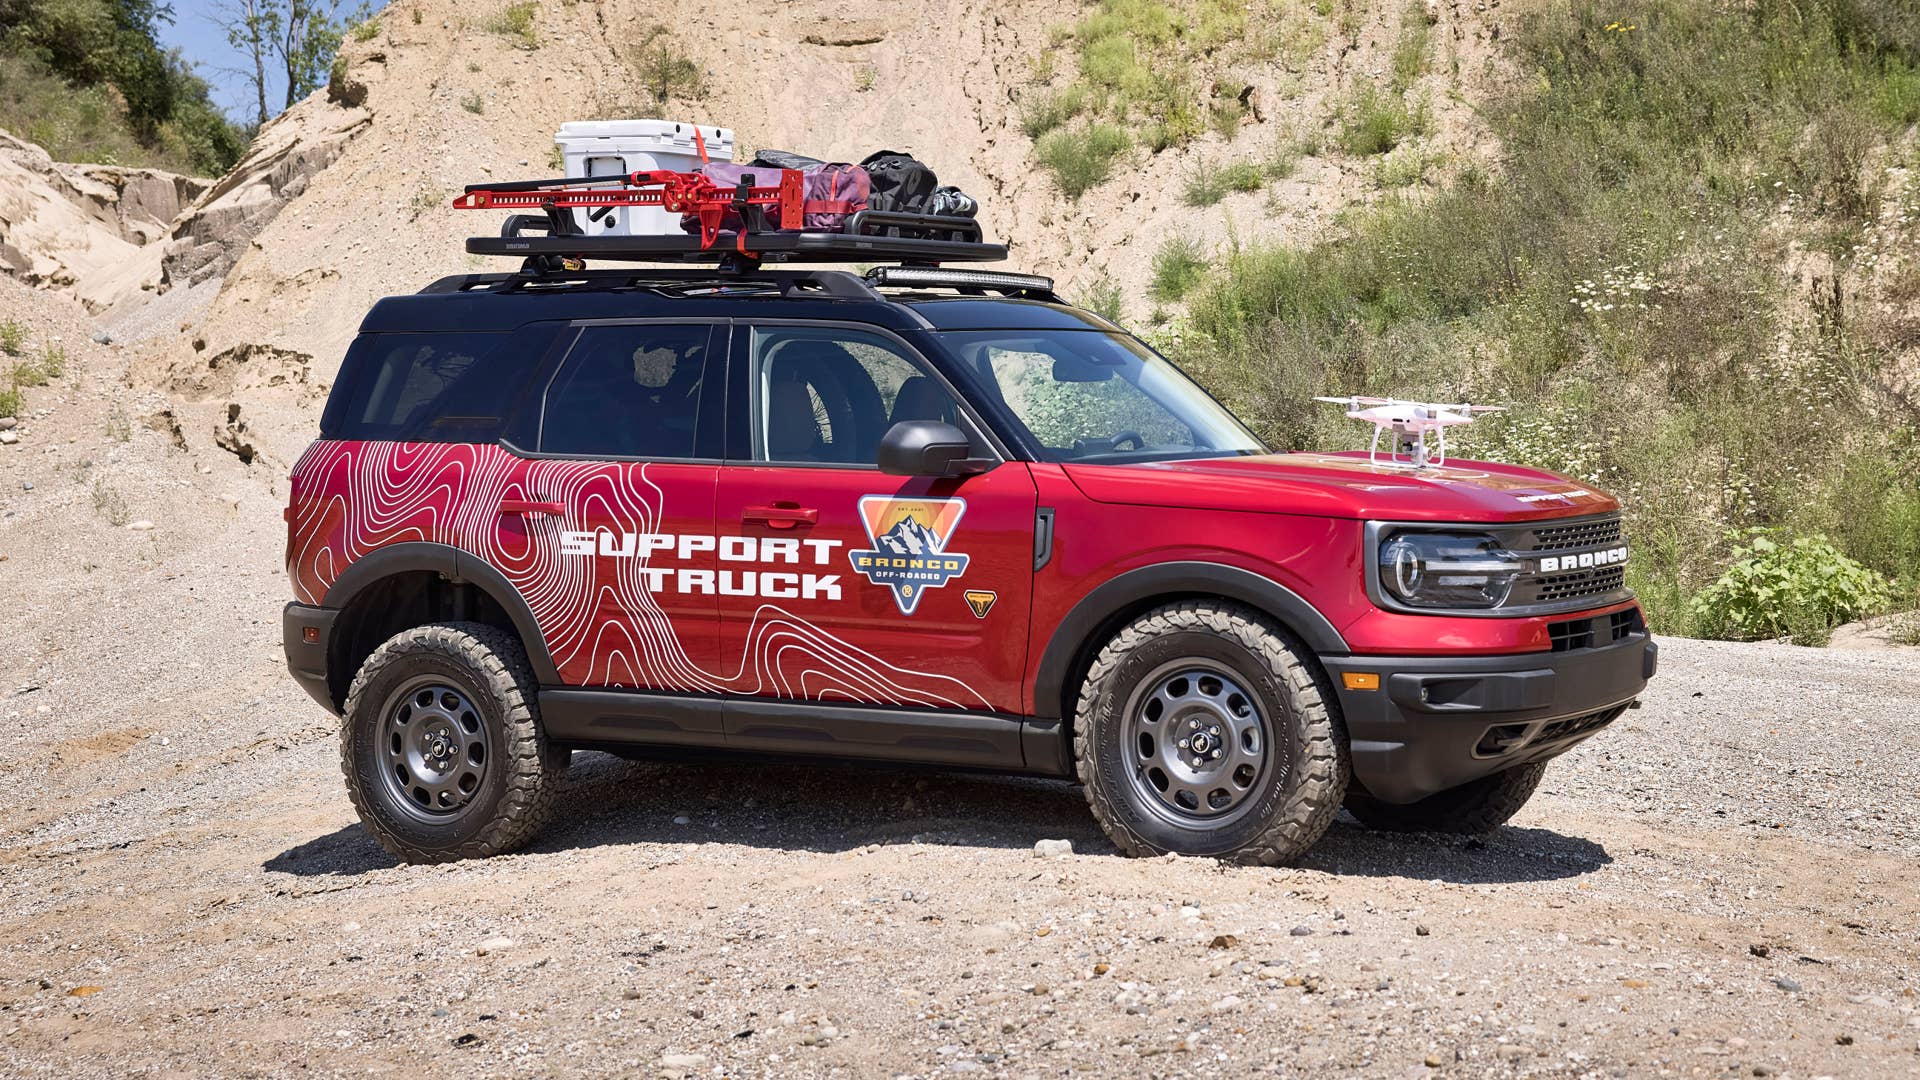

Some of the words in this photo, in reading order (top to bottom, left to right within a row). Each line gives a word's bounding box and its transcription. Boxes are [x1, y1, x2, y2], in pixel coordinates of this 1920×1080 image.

[561, 531, 843, 565] SUPPORT
[1540, 547, 1627, 572] BRONCO
[858, 557, 959, 570] BRONCO
[639, 568, 842, 601] TRUCK
